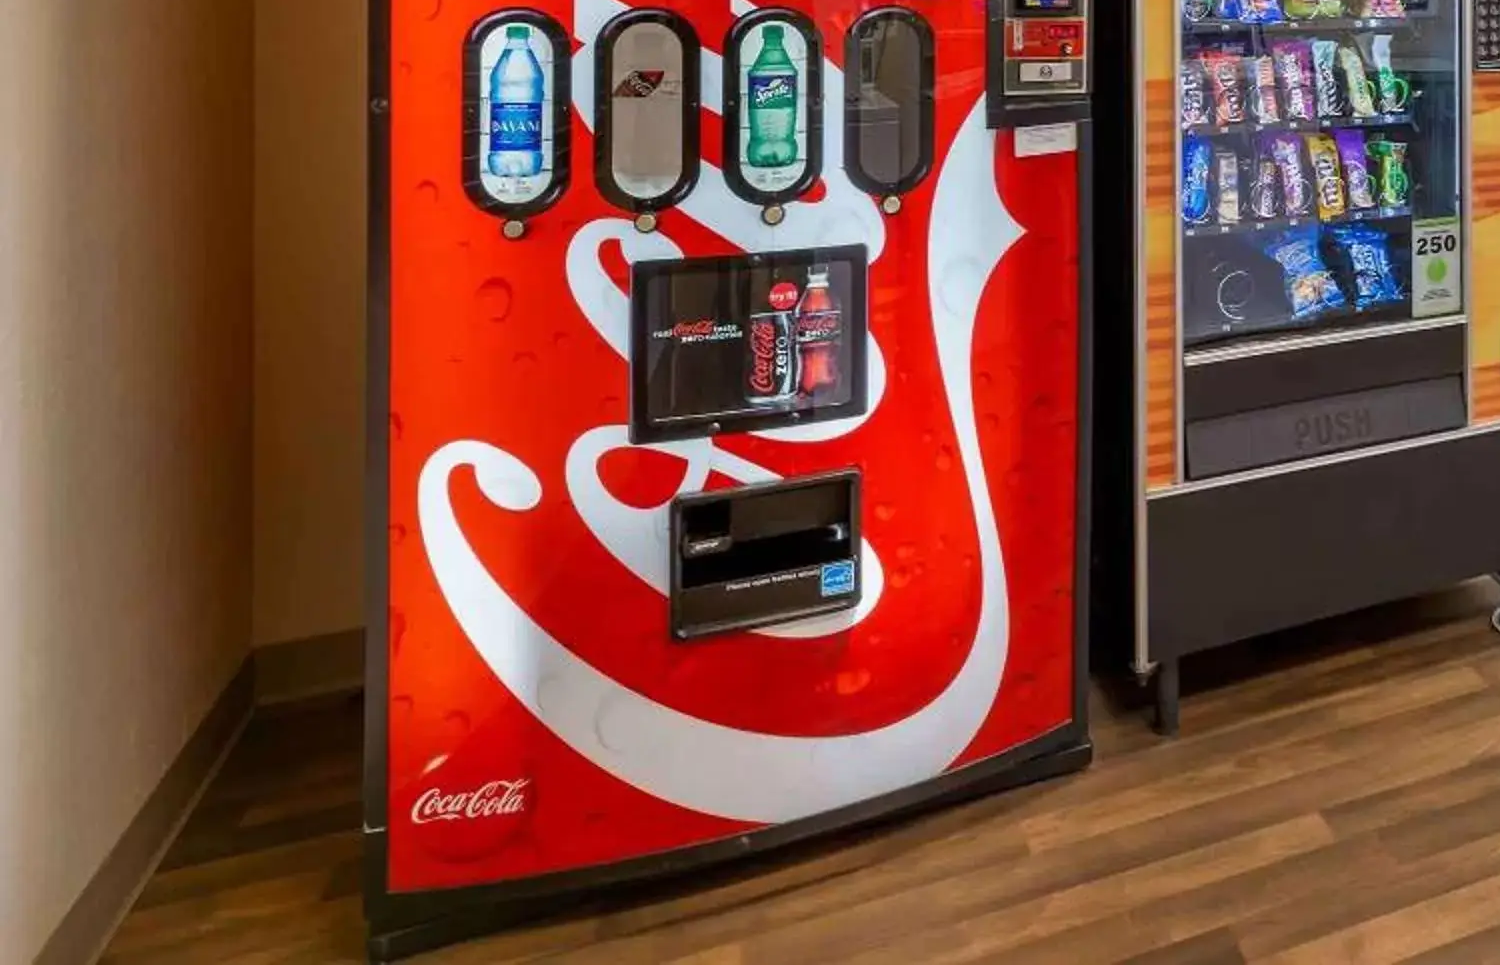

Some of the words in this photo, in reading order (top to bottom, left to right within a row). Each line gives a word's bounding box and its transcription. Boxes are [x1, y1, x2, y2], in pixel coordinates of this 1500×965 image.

[1416, 235, 1456, 255] 250
[776, 336, 787, 376] zero
[1295, 409, 1370, 448] PUSH
[411, 779, 530, 824] Coca-Cola
